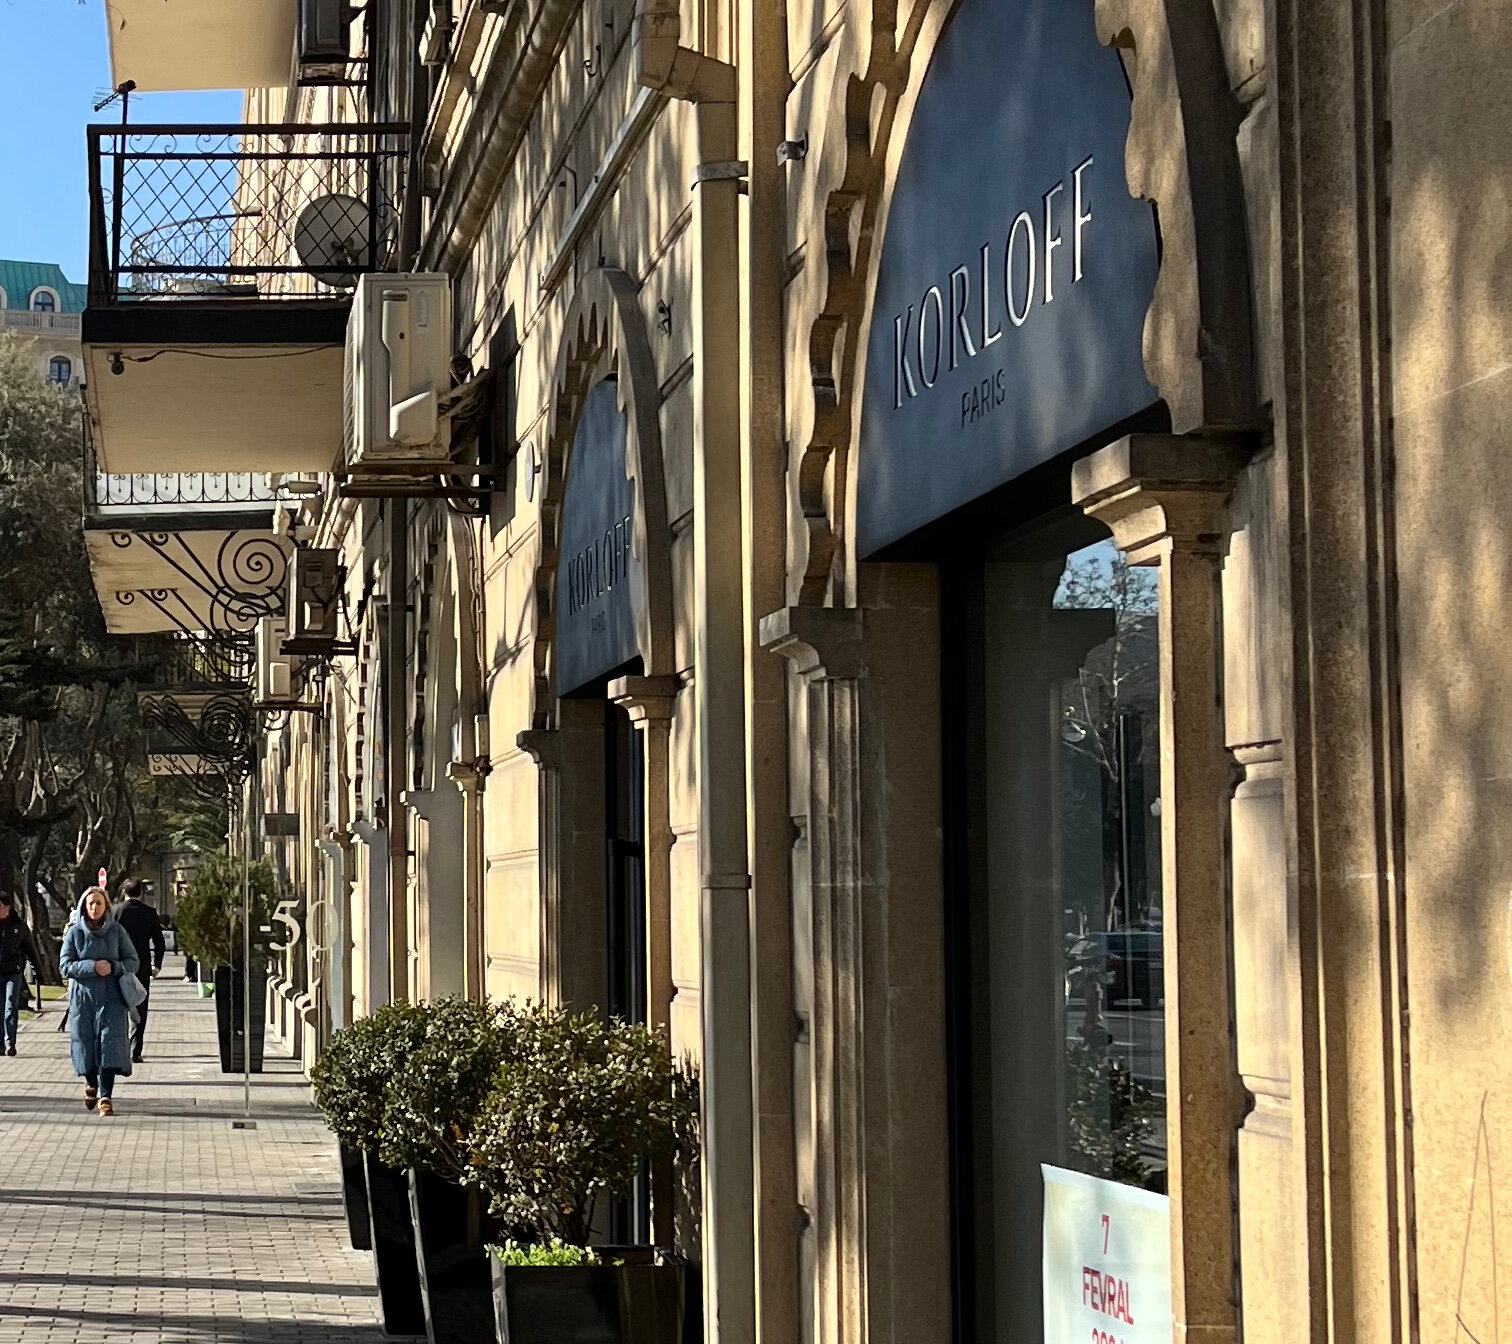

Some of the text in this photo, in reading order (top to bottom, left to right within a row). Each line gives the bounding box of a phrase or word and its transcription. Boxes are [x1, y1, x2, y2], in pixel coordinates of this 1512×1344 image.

[893, 154, 1094, 411] KORLOFF
[961, 368, 1006, 429] PARIS
[568, 514, 630, 617] KORLOFF
[1101, 1214, 1110, 1256] 7
[1082, 1266, 1135, 1326] FEVRAL
